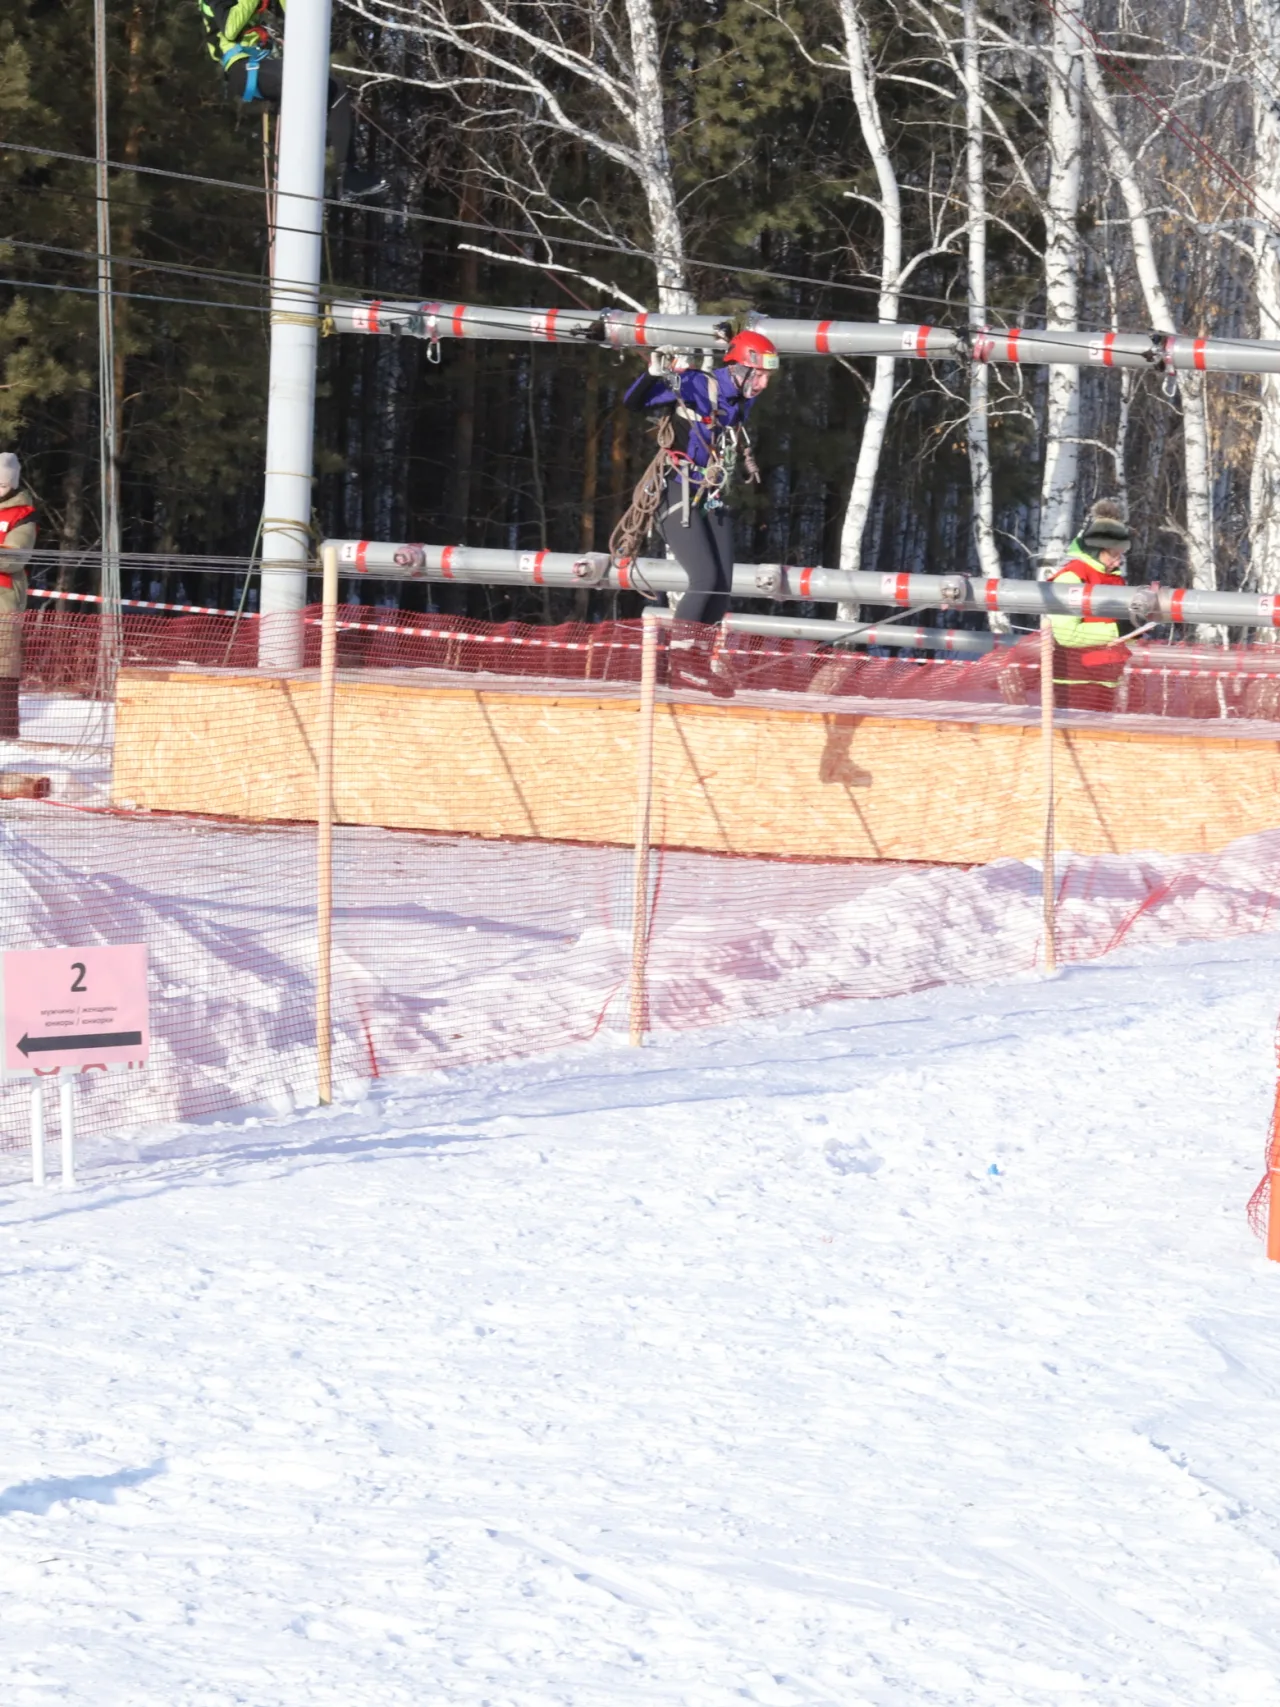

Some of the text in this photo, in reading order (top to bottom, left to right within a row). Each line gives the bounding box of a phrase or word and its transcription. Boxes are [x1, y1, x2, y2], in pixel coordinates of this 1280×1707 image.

[903, 333, 912, 347] 4
[1090, 342, 1099, 356] 5
[346, 546, 352, 558] 1
[521, 557, 530, 570] 2
[1260, 599, 1269, 611] 6
[70, 962, 87, 992] 2
